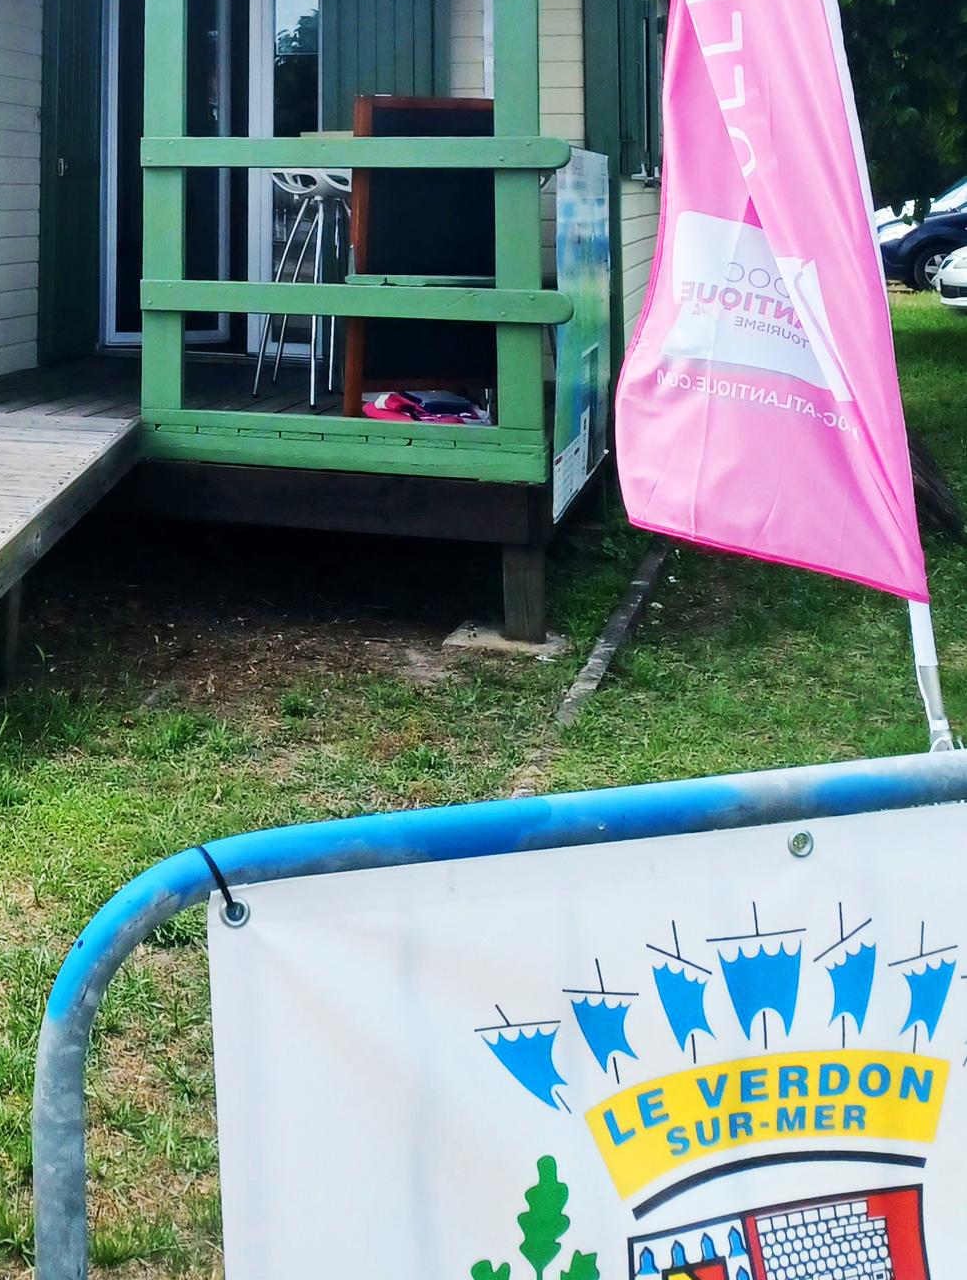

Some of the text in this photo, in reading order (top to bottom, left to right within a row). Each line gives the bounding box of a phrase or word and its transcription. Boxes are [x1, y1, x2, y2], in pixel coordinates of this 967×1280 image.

[603, 1063, 934, 1146] LE VERDON
[666, 1104, 867, 1157] SUR-MER
